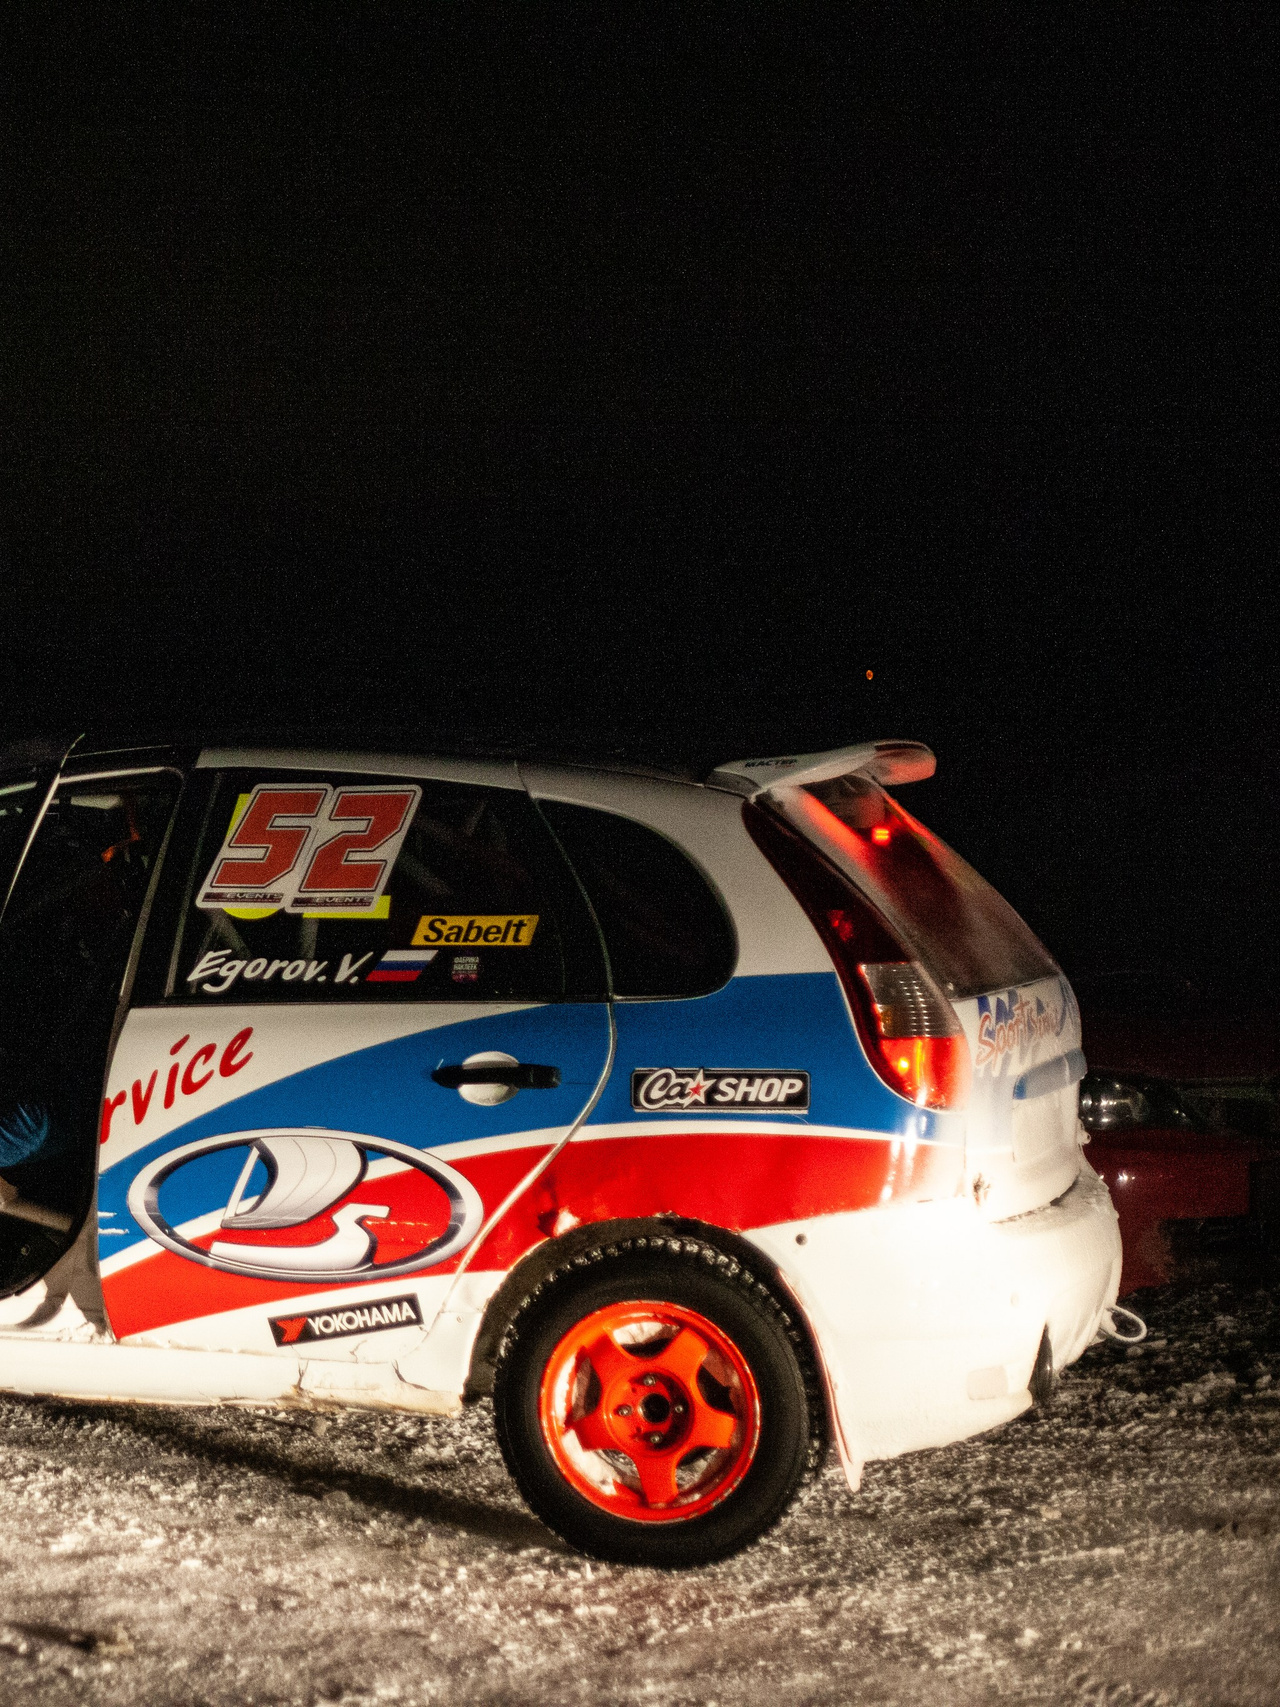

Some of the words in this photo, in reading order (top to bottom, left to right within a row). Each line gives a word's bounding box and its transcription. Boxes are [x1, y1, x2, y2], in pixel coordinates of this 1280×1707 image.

[211, 789, 417, 892] 52
[423, 918, 527, 943] Sabelt
[334, 951, 374, 984] V.
[714, 1077, 803, 1102] SHOP
[308, 1301, 417, 1336] YOKOHAMA
